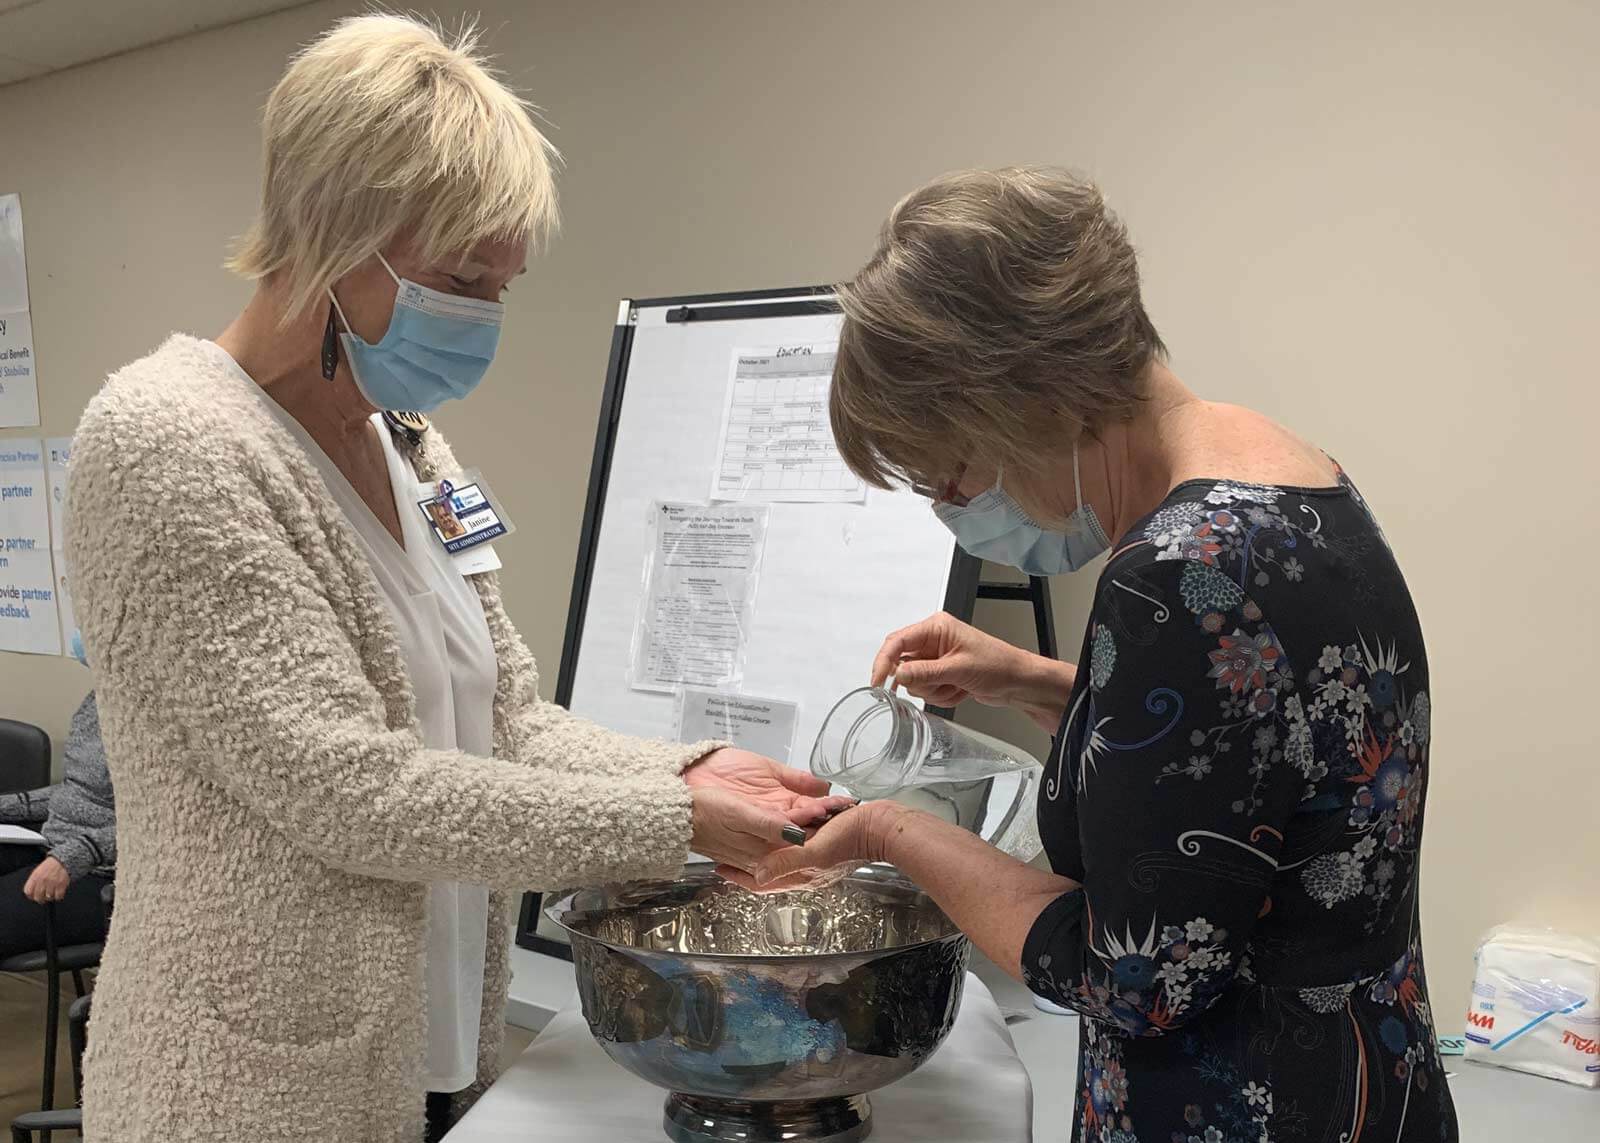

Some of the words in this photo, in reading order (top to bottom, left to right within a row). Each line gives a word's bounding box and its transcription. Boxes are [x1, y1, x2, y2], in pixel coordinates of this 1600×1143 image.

[9, 347, 29, 359] Benefit
[399, 411, 423, 425] RN
[1, 485, 32, 501] partner
[468, 515, 491, 529] Janine
[459, 526, 503, 547] ADMINISTRATOR
[6, 537, 35, 552] partner
[22, 588, 52, 603] partner
